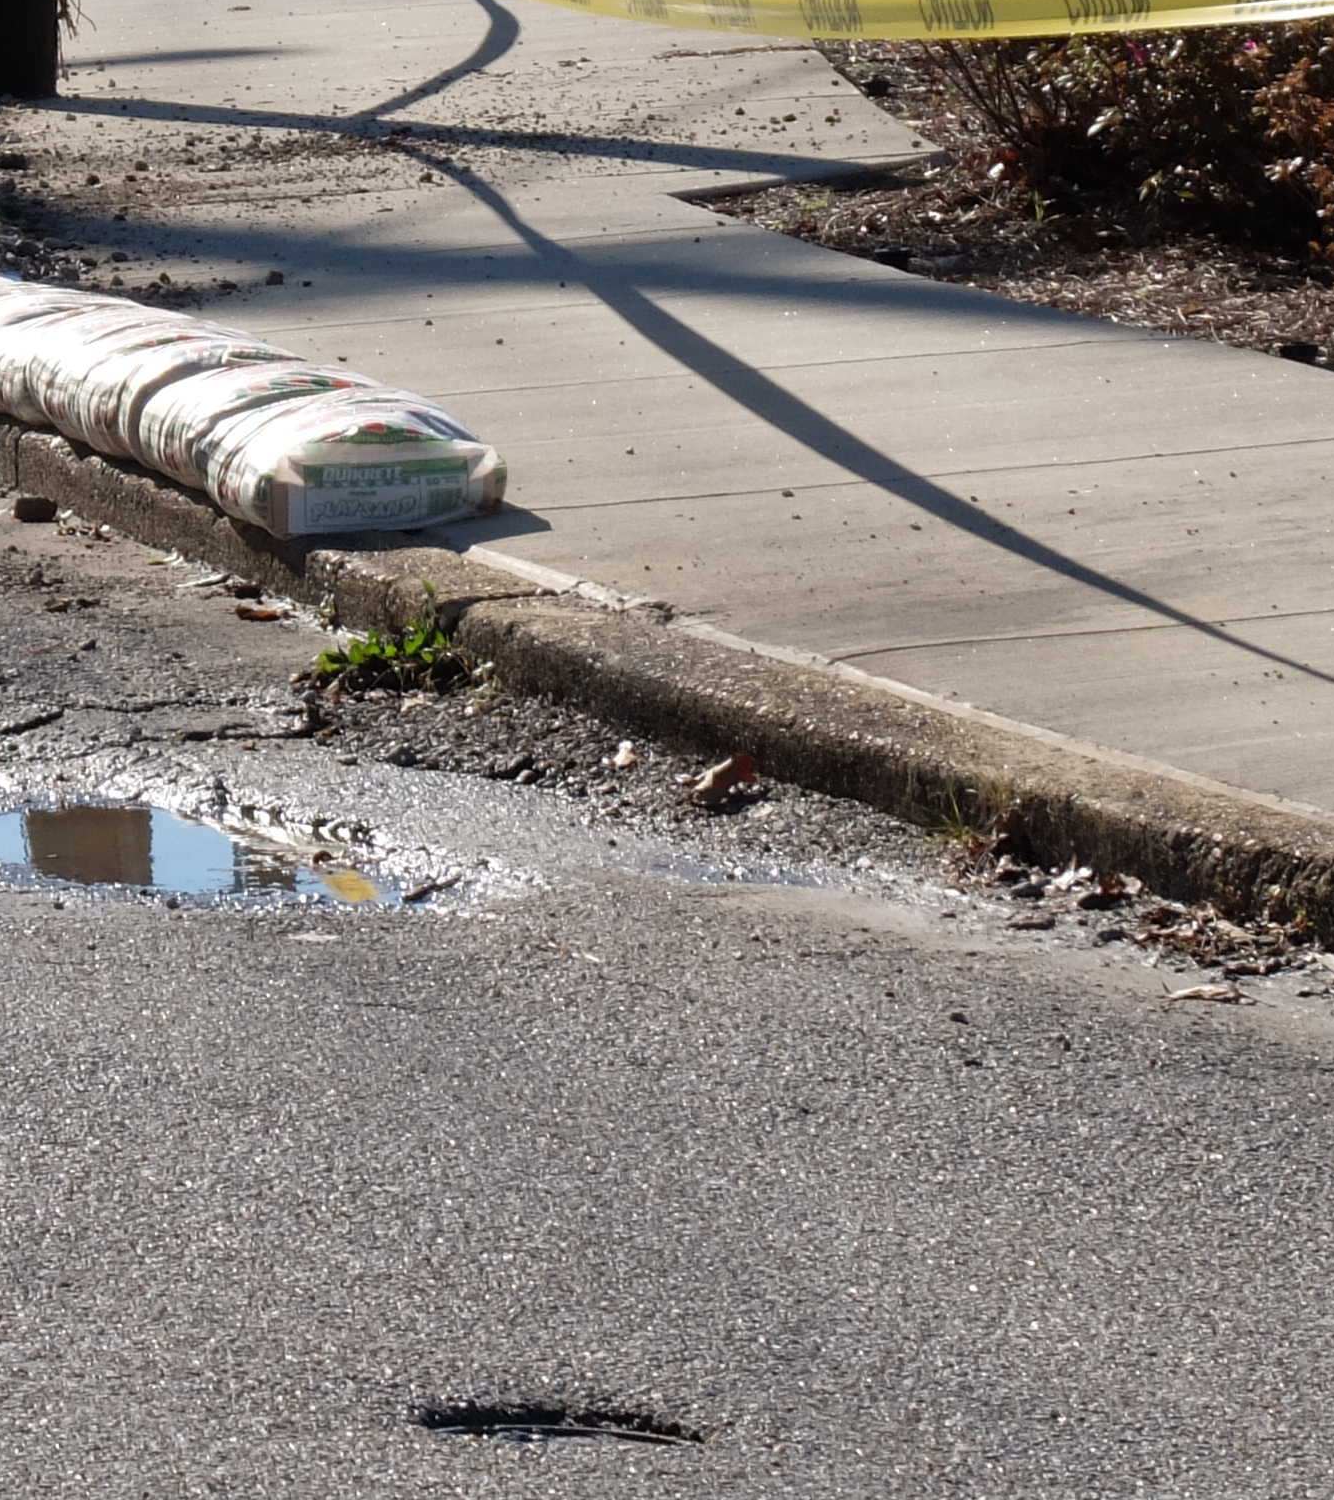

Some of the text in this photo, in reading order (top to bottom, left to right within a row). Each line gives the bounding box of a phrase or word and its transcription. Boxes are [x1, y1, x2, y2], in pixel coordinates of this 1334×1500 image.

[322, 466, 402, 482] QUIKRETE
[310, 495, 417, 522] PLAY SAND
